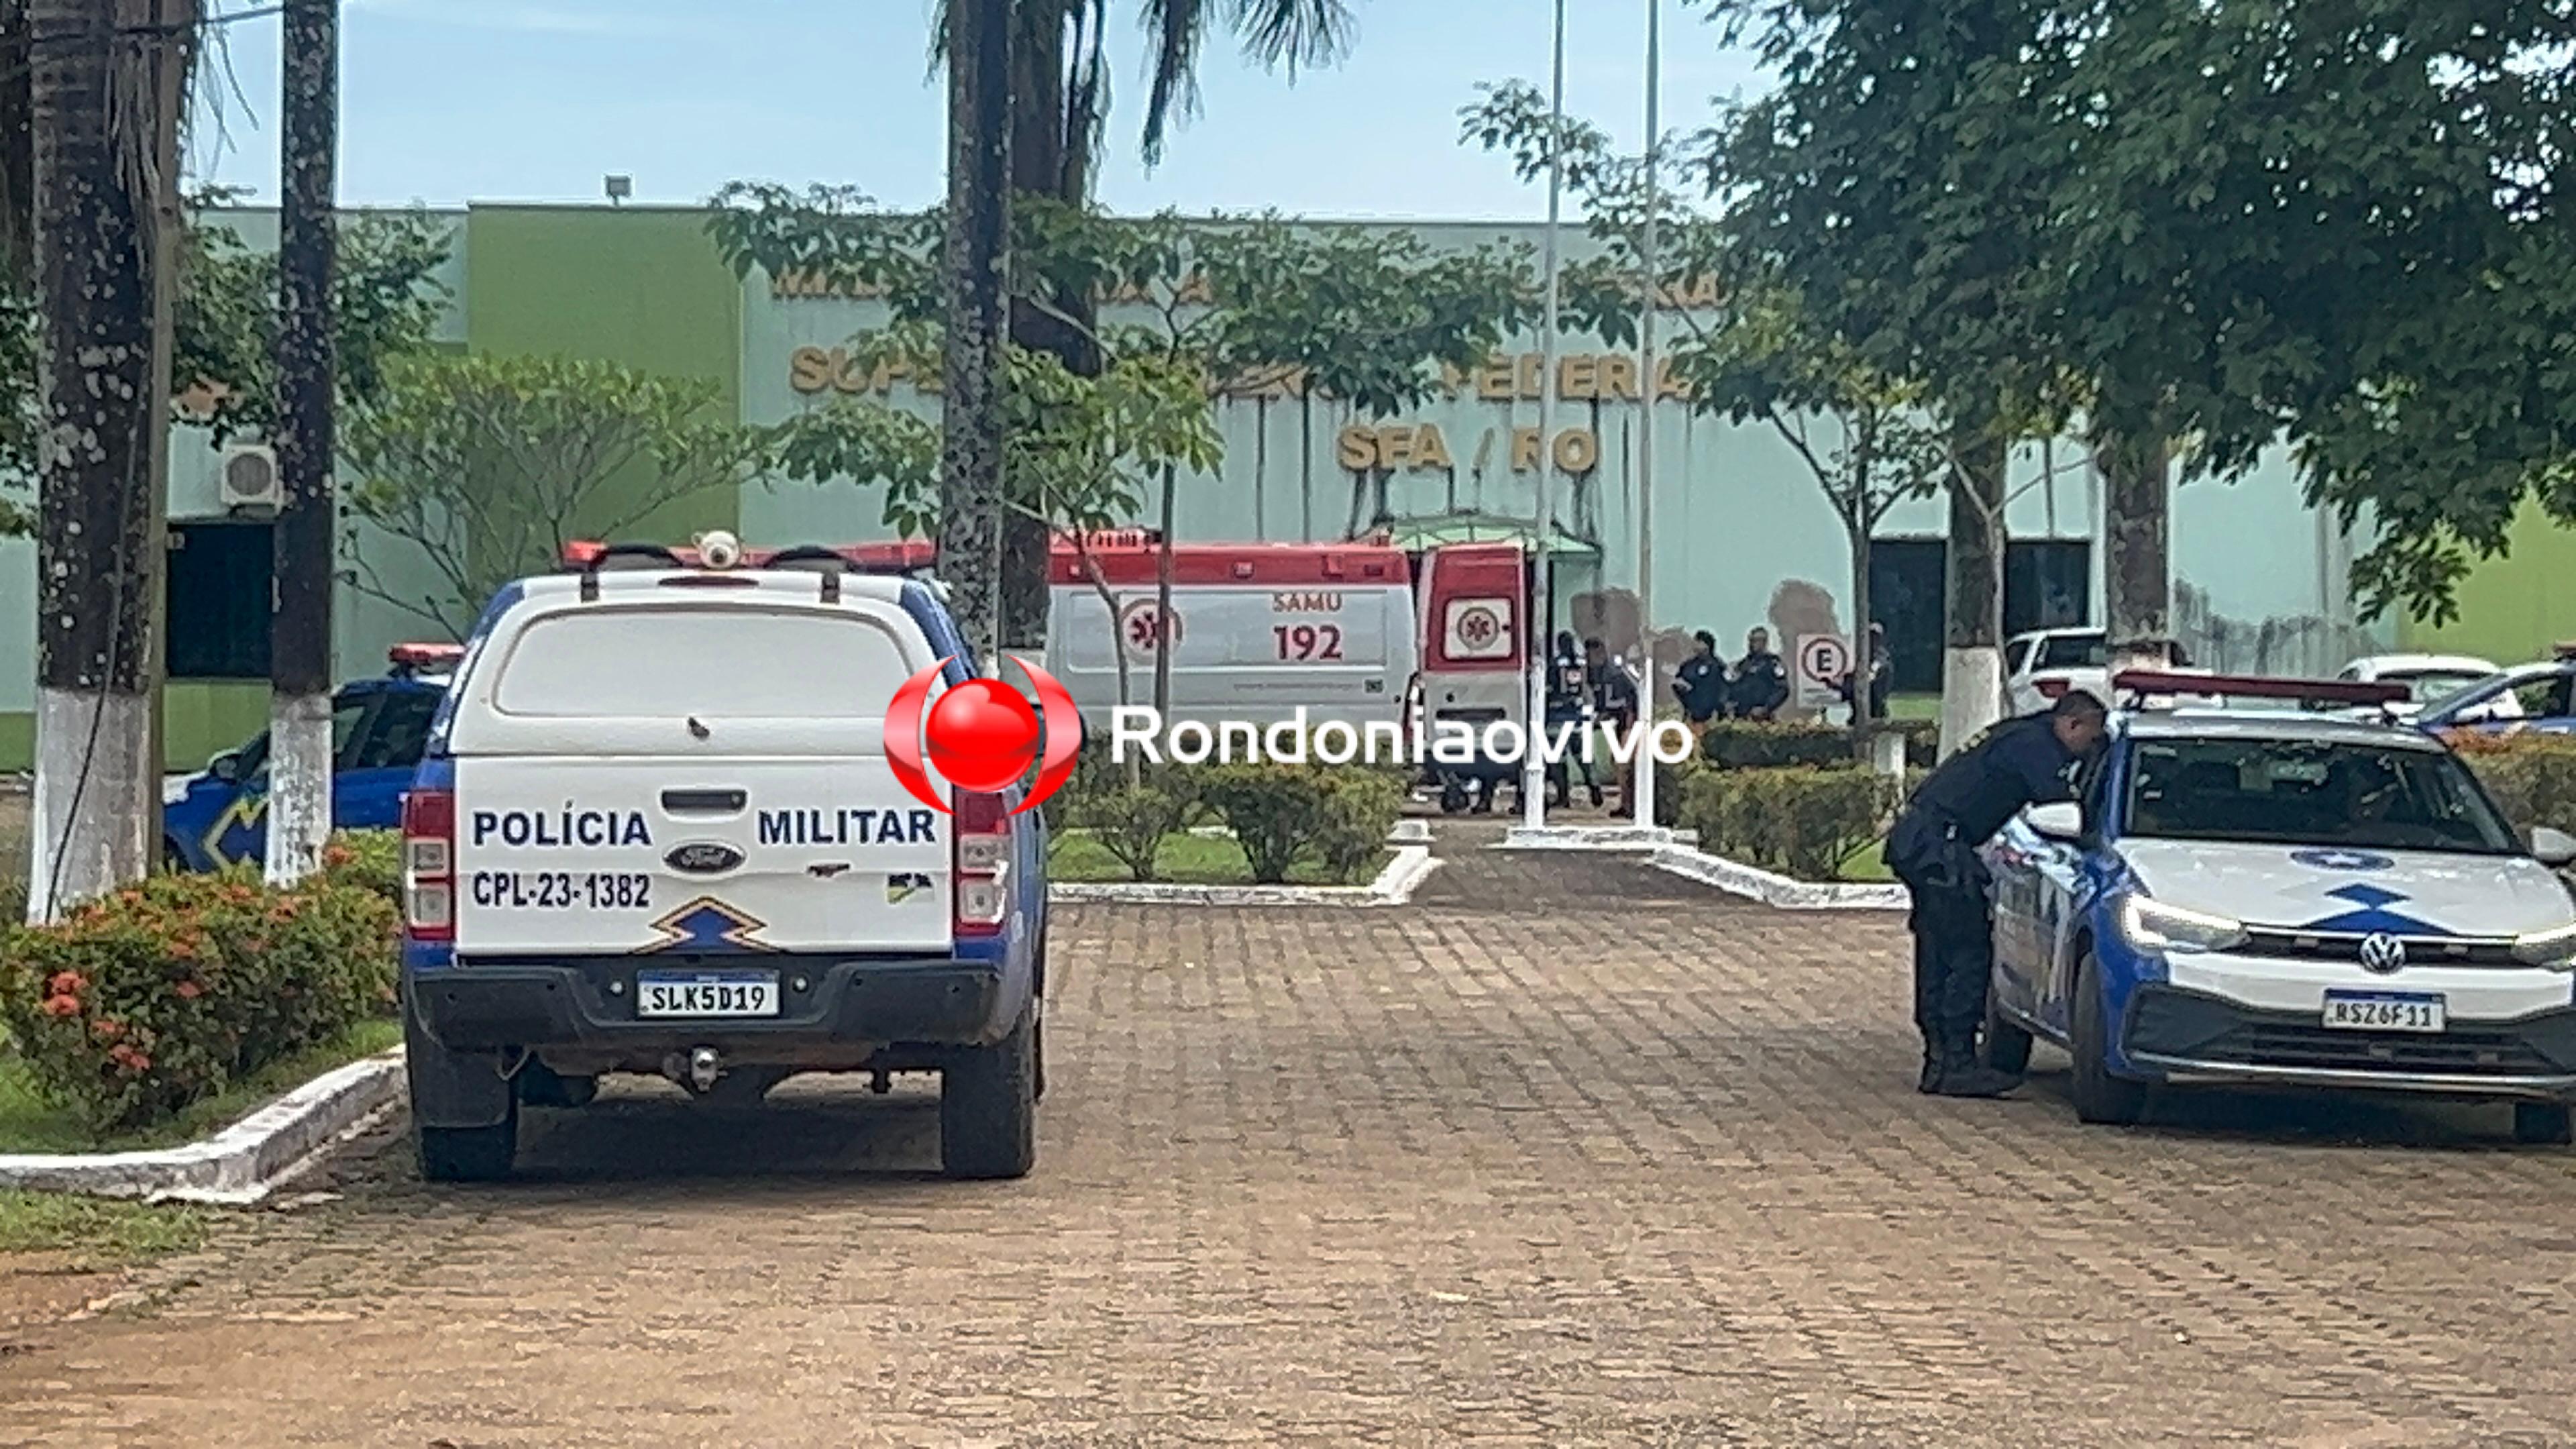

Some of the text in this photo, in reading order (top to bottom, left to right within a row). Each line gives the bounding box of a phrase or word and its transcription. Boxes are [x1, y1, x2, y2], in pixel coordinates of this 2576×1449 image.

[1339, 423, 1450, 472] SFA
[1511, 427, 1598, 474] RO
[1273, 591, 1342, 612] SAMU
[1274, 625, 1342, 659] 192
[1817, 649, 1832, 672] E
[473, 799, 936, 846] POLÍCIA MILITAR
[473, 871, 651, 907] CPL-23-1382
[652, 985, 764, 1010] SLK5D19
